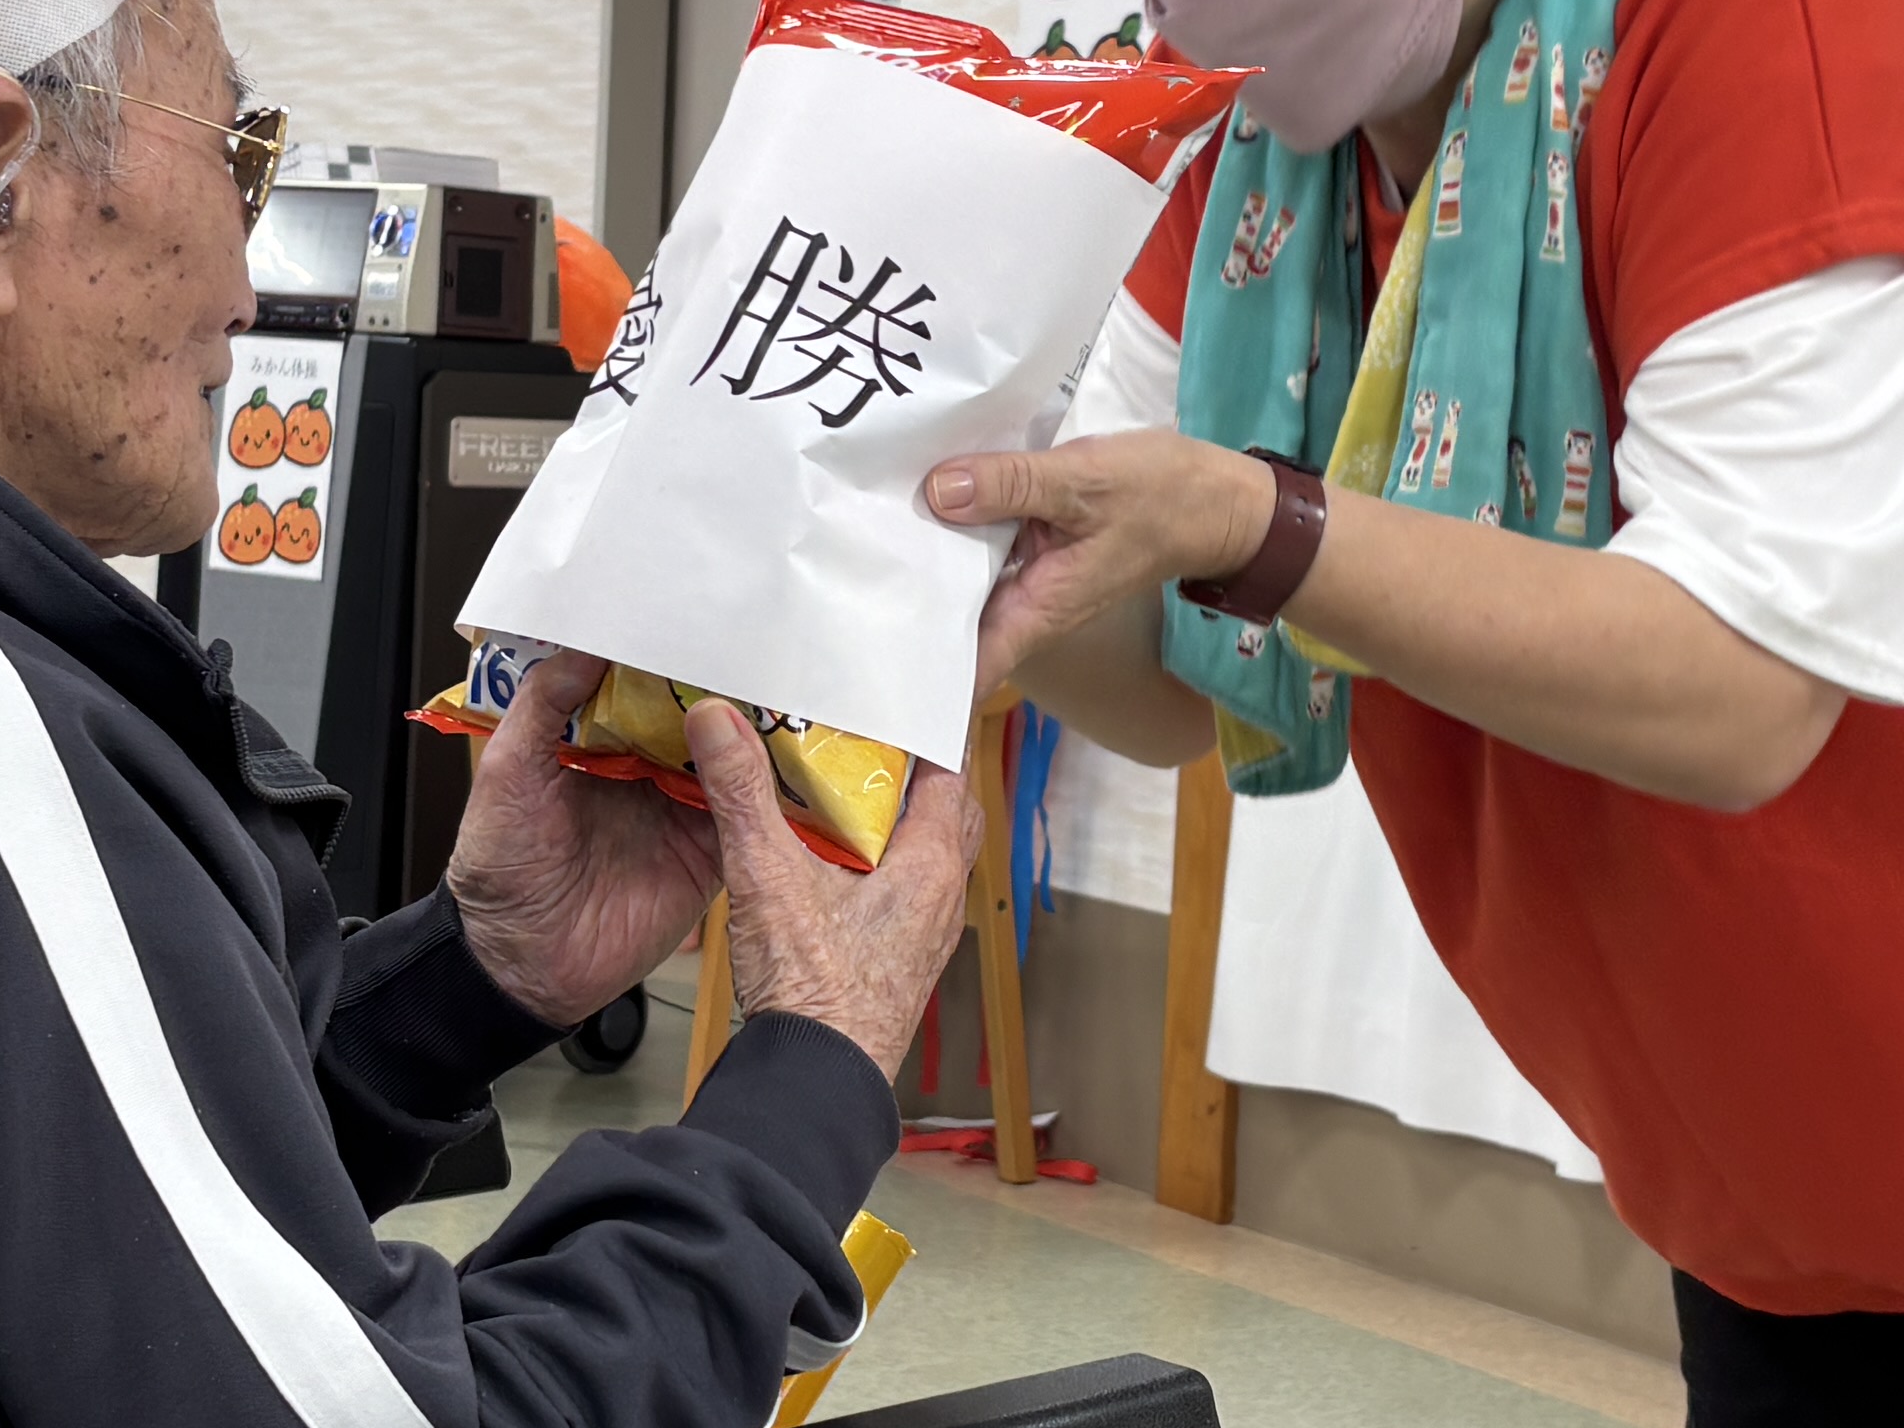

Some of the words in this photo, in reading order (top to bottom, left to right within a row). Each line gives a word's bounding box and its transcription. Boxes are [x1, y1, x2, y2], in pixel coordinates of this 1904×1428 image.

[250, 356, 318, 379] みかん体操
[470, 641, 546, 710] 16
